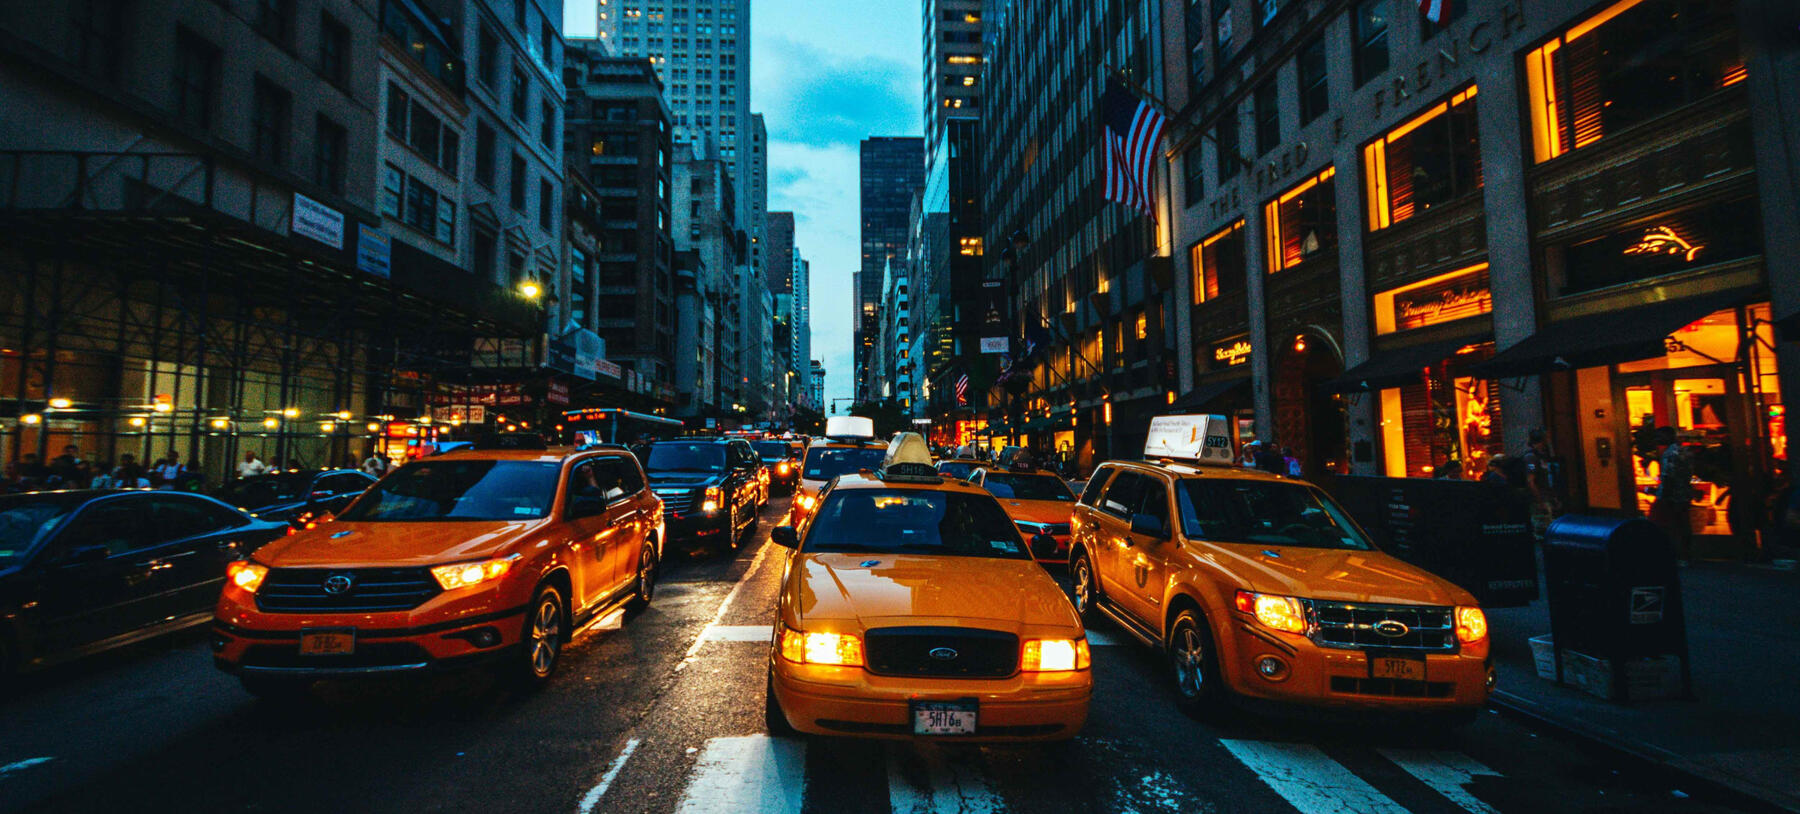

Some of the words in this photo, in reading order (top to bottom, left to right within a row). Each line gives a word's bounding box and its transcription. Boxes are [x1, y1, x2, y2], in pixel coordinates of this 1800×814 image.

[1210, 187, 1238, 220] THE
[1256, 141, 1308, 193] FRED
[1374, 0, 1527, 120] FRENCH
[901, 464, 925, 476] 5H16
